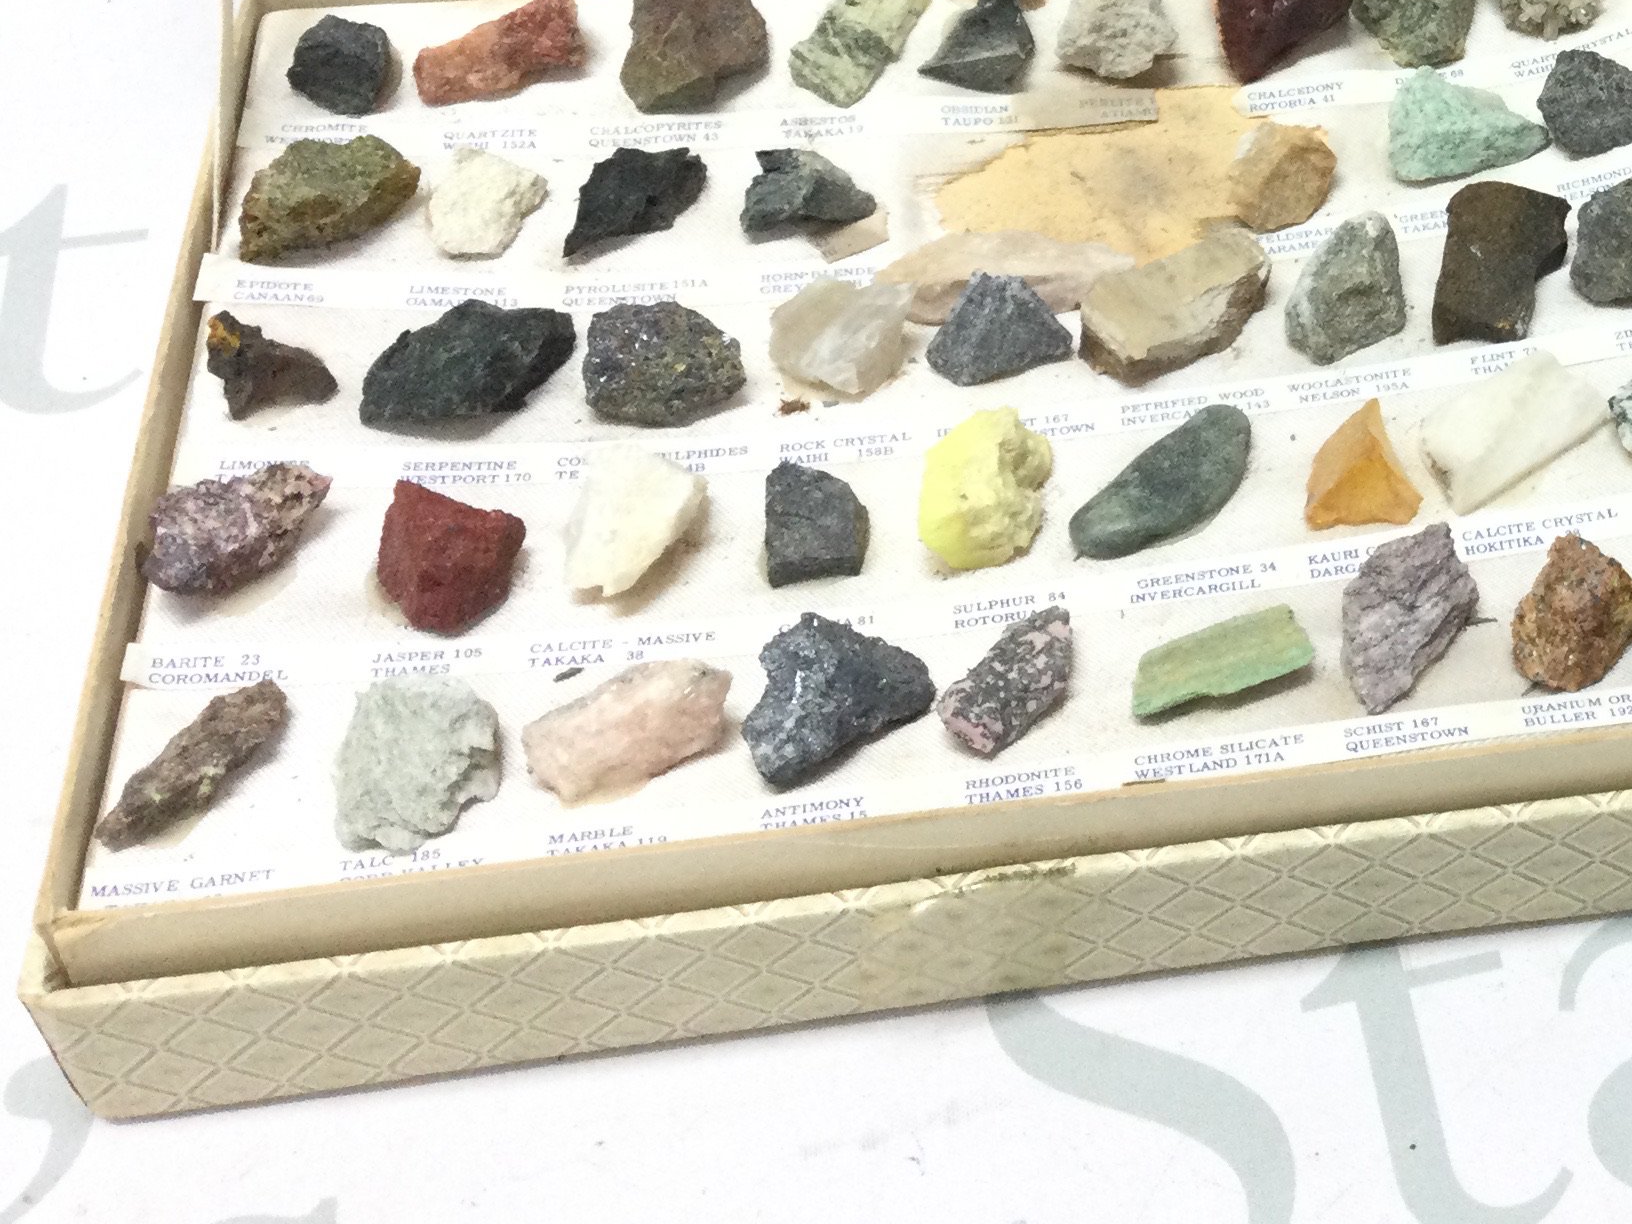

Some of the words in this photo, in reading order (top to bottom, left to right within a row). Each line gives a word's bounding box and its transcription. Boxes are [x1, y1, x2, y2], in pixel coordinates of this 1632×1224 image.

[1511, 53, 1557, 69] QUART
[1248, 81, 1345, 100] CHALCEDONY
[941, 105, 1010, 115] OBSIDIAN
[1250, 98, 1317, 113] ROTORUA
[1322, 94, 1335, 103] 41
[780, 115, 857, 127] ASBESTOS
[941, 116, 995, 127] TAUPO
[443, 129, 537, 140] QUARTZITE
[589, 133, 697, 148] QUEENSTOWN
[236, 279, 314, 292] EPIDOTE
[409, 285, 507, 296] LIMESTONE
[565, 281, 672, 295] PYROLUSITE
[233, 290, 305, 302] CANAAN
[562, 292, 678, 307] QUEENSTOWN
[1471, 350, 1516, 365] FLINT
[1286, 368, 1412, 394] WOOLASTONITE
[1121, 396, 1208, 414] PETRIFIED
[1218, 388, 1265, 401] WOOD
[1299, 386, 1361, 404] NELSON
[779, 440, 827, 453] ROCK
[833, 431, 913, 448] CRYSTAL
[402, 460, 518, 472] SERPENTINE
[780, 452, 829, 464] WAIHI
[1462, 520, 1536, 543] CALCITE
[1541, 507, 1619, 530] CRYSTAL
[1465, 534, 1545, 557] HOKITIKA
[1308, 547, 1359, 565] KAURI
[1137, 563, 1253, 590] GREENSTONE
[1260, 561, 1277, 573] 34
[1130, 579, 1261, 604] INVERCARGILL
[953, 595, 1036, 615] SULPHUR
[530, 638, 613, 654] CALCITE
[637, 630, 716, 647] MASSIVE
[151, 655, 225, 670] BARITE
[240, 654, 261, 666] 23
[373, 651, 445, 664] JASPER
[453, 647, 483, 659] 105
[527, 653, 605, 669] TAKAKA
[149, 669, 289, 685] COROMANDEL
[371, 663, 451, 678] THAMES
[1521, 695, 1603, 717] URANIUM
[1343, 719, 1405, 738] SCHIST
[1411, 716, 1439, 729] 167
[1524, 711, 1598, 729] BULLER
[1345, 724, 1471, 754] QUEENSTOWN
[1134, 746, 1213, 766] CHROME
[1219, 732, 1305, 755] SILICATE
[1133, 757, 1239, 780] WESTLAND
[965, 765, 1076, 791] RHODONITE
[965, 783, 1044, 806] THAMES
[1053, 778, 1083, 793] 156
[761, 796, 864, 819] ANTIMONY
[548, 825, 634, 845] MARBLE
[339, 856, 394, 872] TALC
[411, 848, 441, 863] 185
[90, 878, 180, 898] MASSIVE
[190, 868, 276, 891] GARNET
